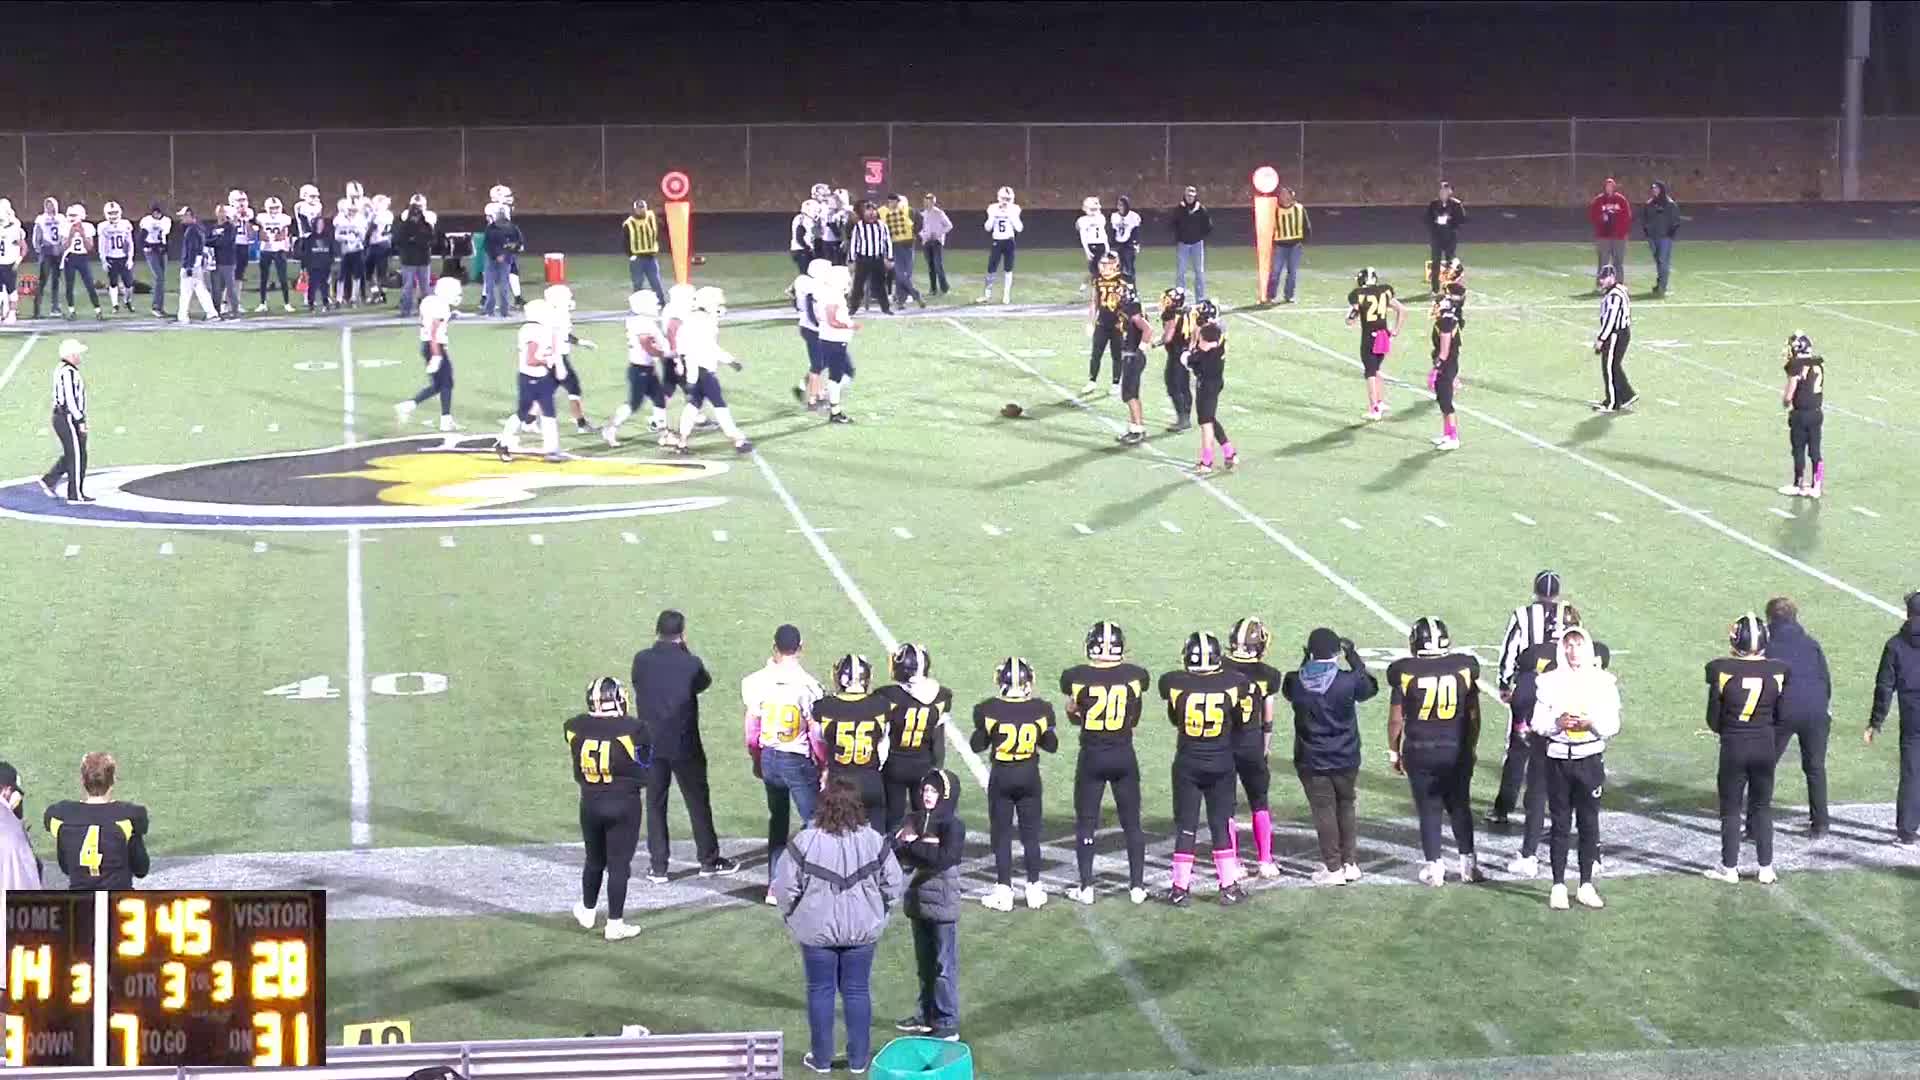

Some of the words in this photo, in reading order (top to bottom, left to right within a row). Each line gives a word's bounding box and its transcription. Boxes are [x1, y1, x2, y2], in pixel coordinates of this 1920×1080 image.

[864, 161, 884, 184] 3
[50, 226, 58, 241] 3
[73, 238, 81, 251] 2
[110, 235, 123, 249] 10
[1365, 292, 1389, 321] 24
[1084, 684, 1128, 731] 20
[1185, 692, 1225, 737] 65
[1416, 675, 1458, 721] 70
[1738, 677, 1765, 722] 7
[834, 720, 875, 765] 56
[903, 707, 930, 748] 11
[995, 723, 1037, 762] 28
[78, 825, 104, 877] 4
